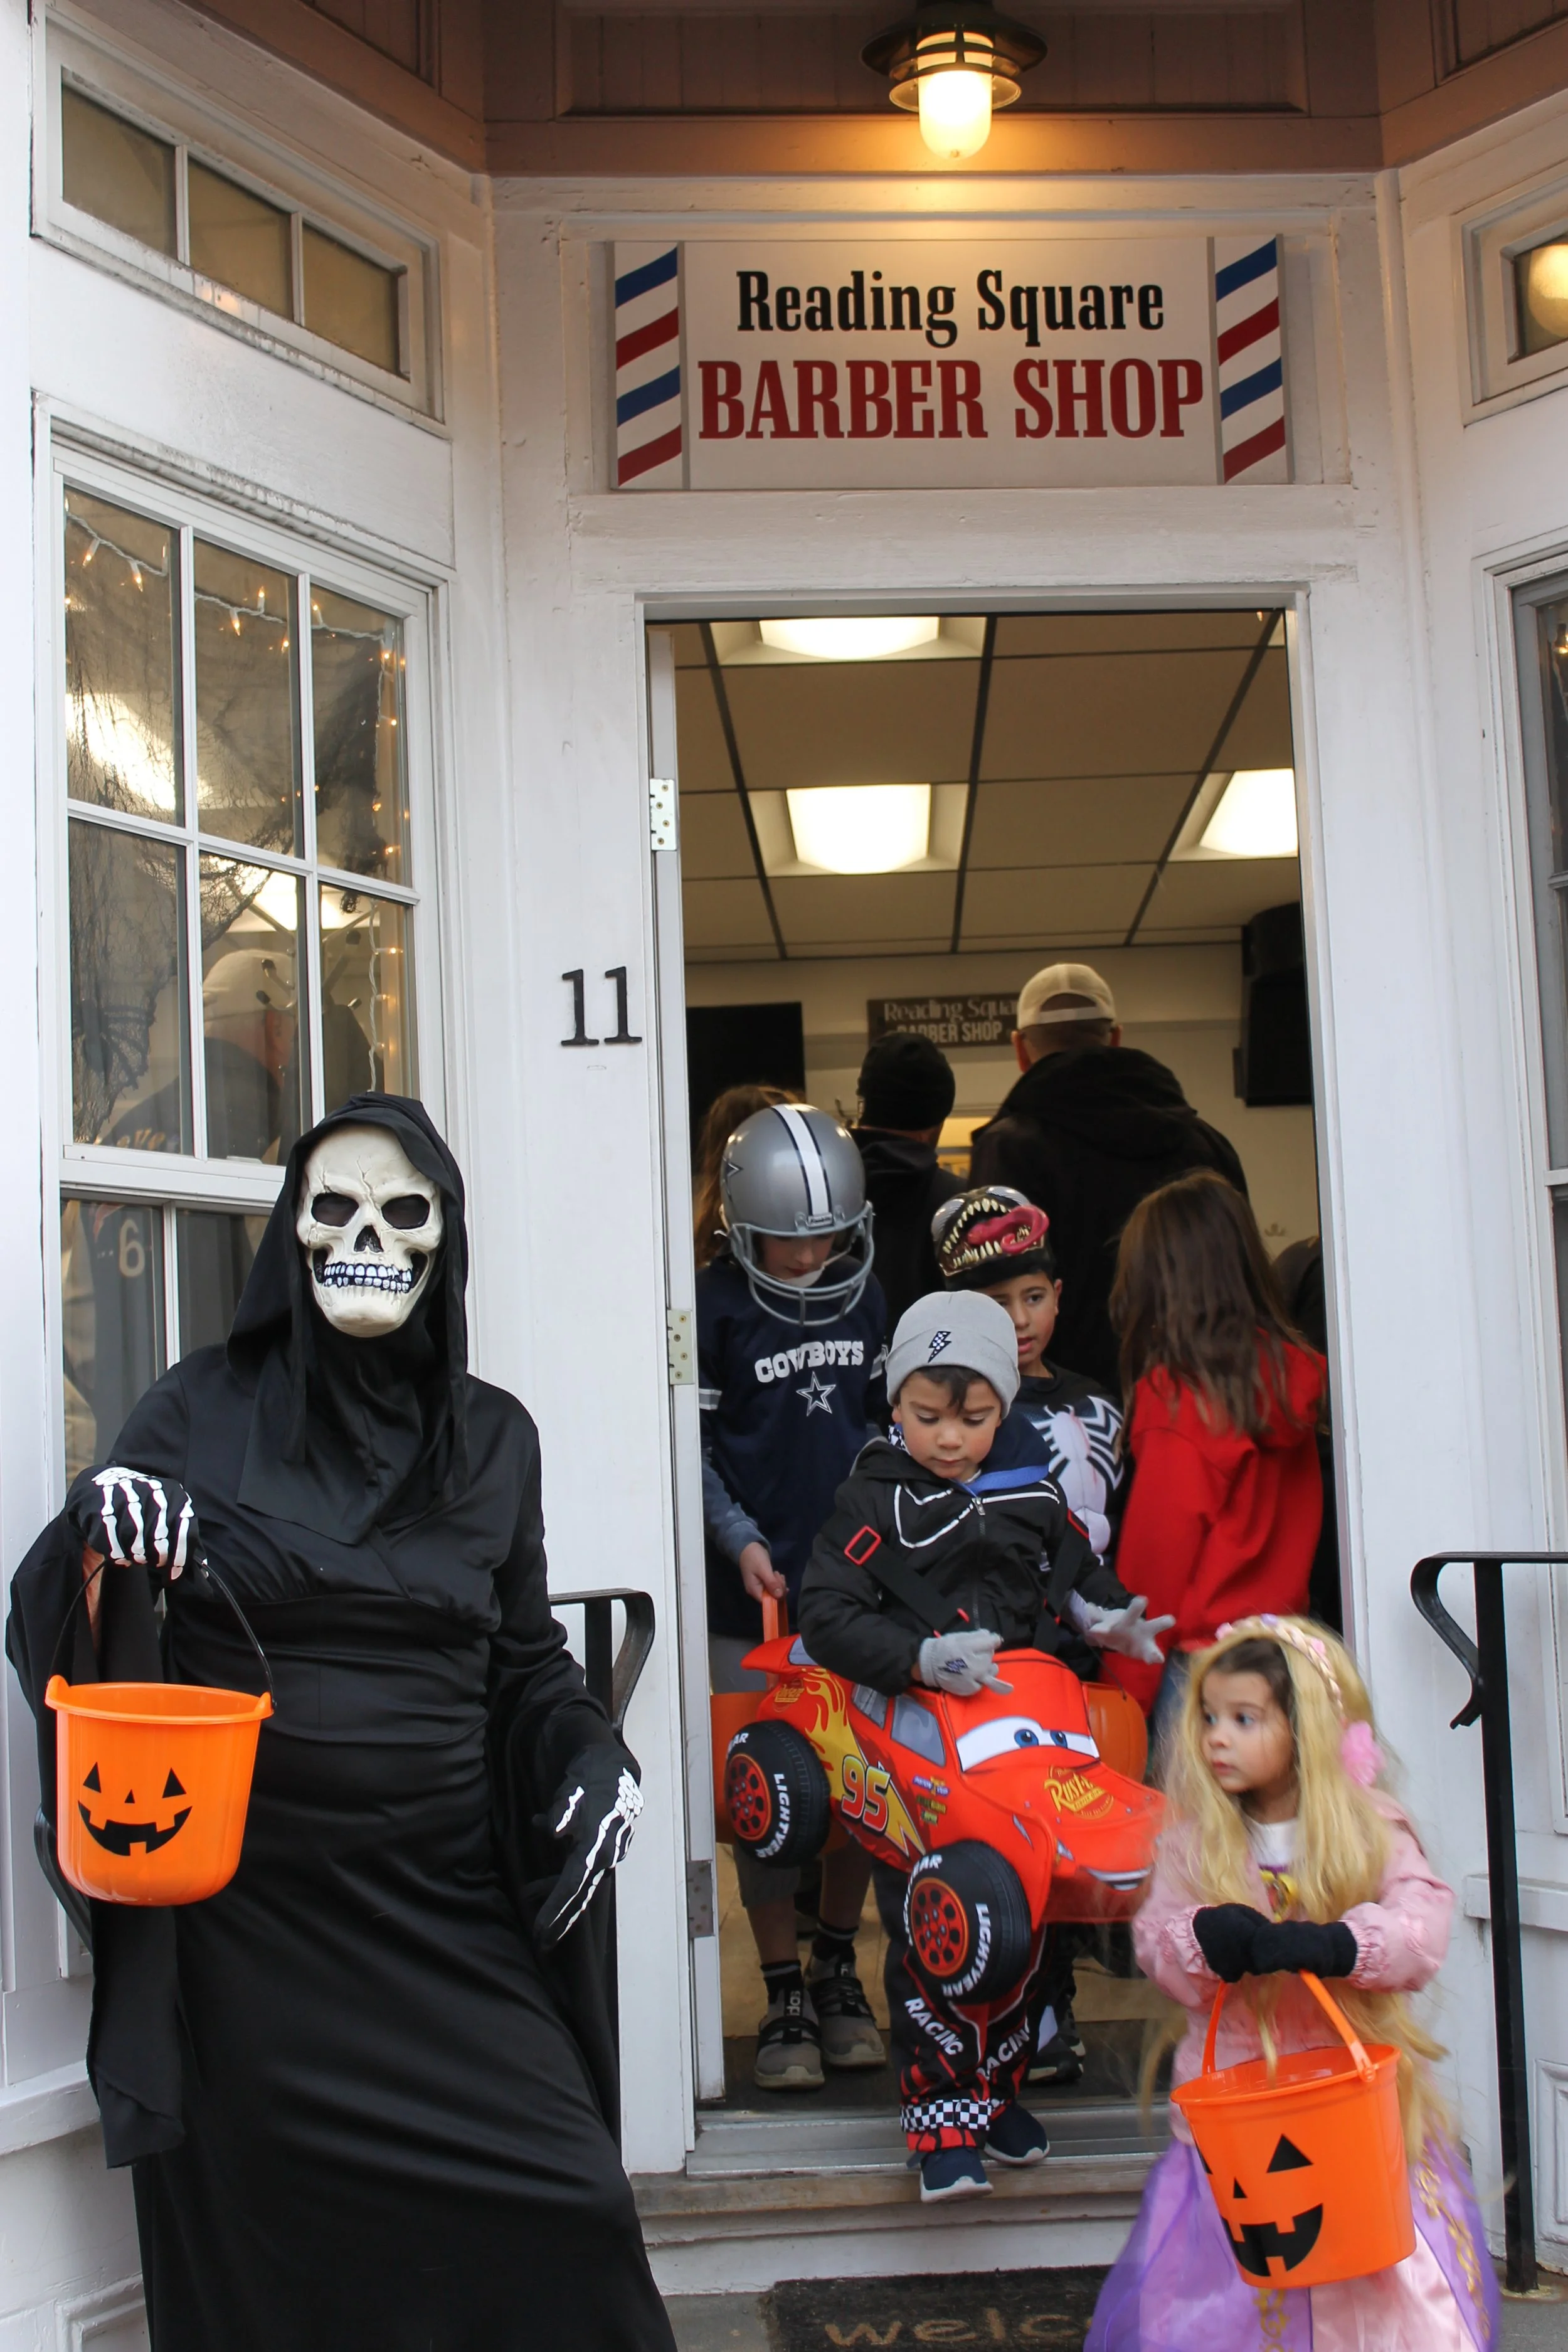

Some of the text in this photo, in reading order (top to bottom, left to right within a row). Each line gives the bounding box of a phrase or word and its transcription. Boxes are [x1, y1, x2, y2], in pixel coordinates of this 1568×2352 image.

[736, 269, 1164, 348] Reading Square
[697, 358, 1204, 440] BARBER SHOP
[561, 966, 642, 1046] 11
[884, 999, 963, 1023] Reading
[961, 1021, 1002, 1042] SHOP
[755, 1340, 864, 1383] COWBOYS
[841, 1754, 891, 1833] 95
[941, 1902, 992, 1997] LIGHTYEAR
[905, 1997, 963, 2055] RACING
[826, 2307, 1091, 2346] welc
